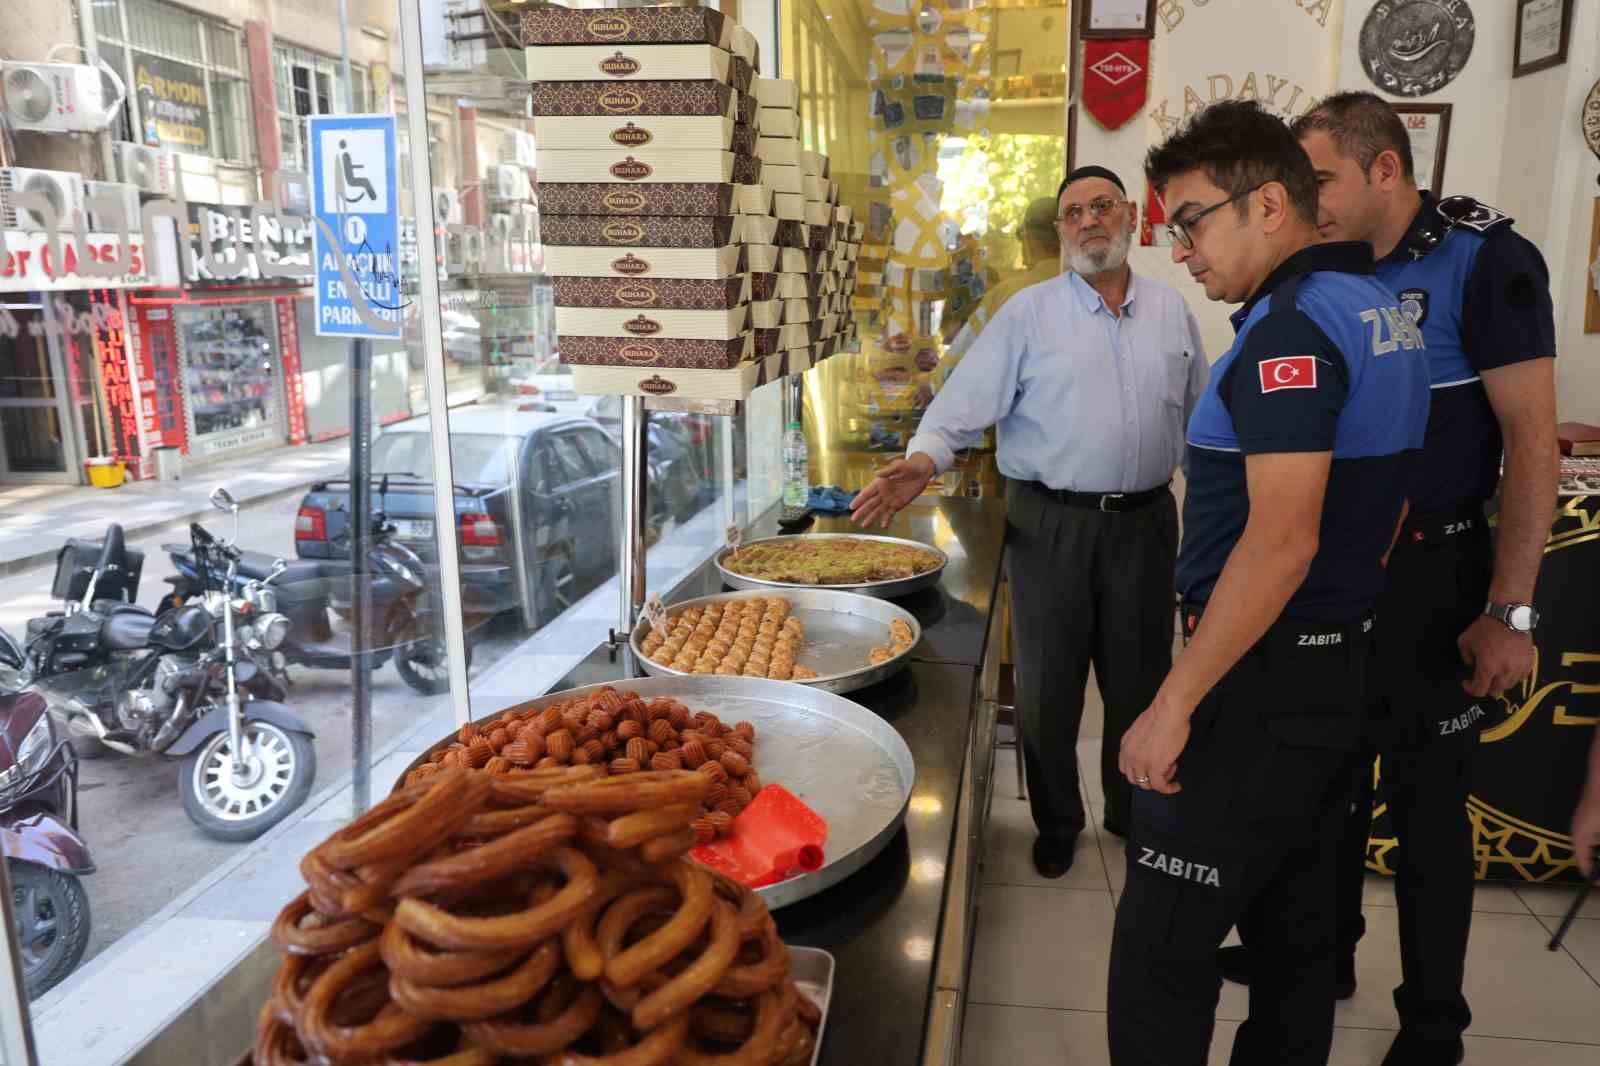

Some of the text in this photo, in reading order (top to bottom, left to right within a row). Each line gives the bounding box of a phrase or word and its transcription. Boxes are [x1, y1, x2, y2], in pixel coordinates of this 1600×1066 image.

[603, 62, 636, 70] BUHARA
[605, 97, 637, 105] BUHARA
[1297, 632, 1342, 646] ZABITA
[1438, 705, 1486, 735] ZABITA
[1137, 846, 1221, 888] ZABITA
